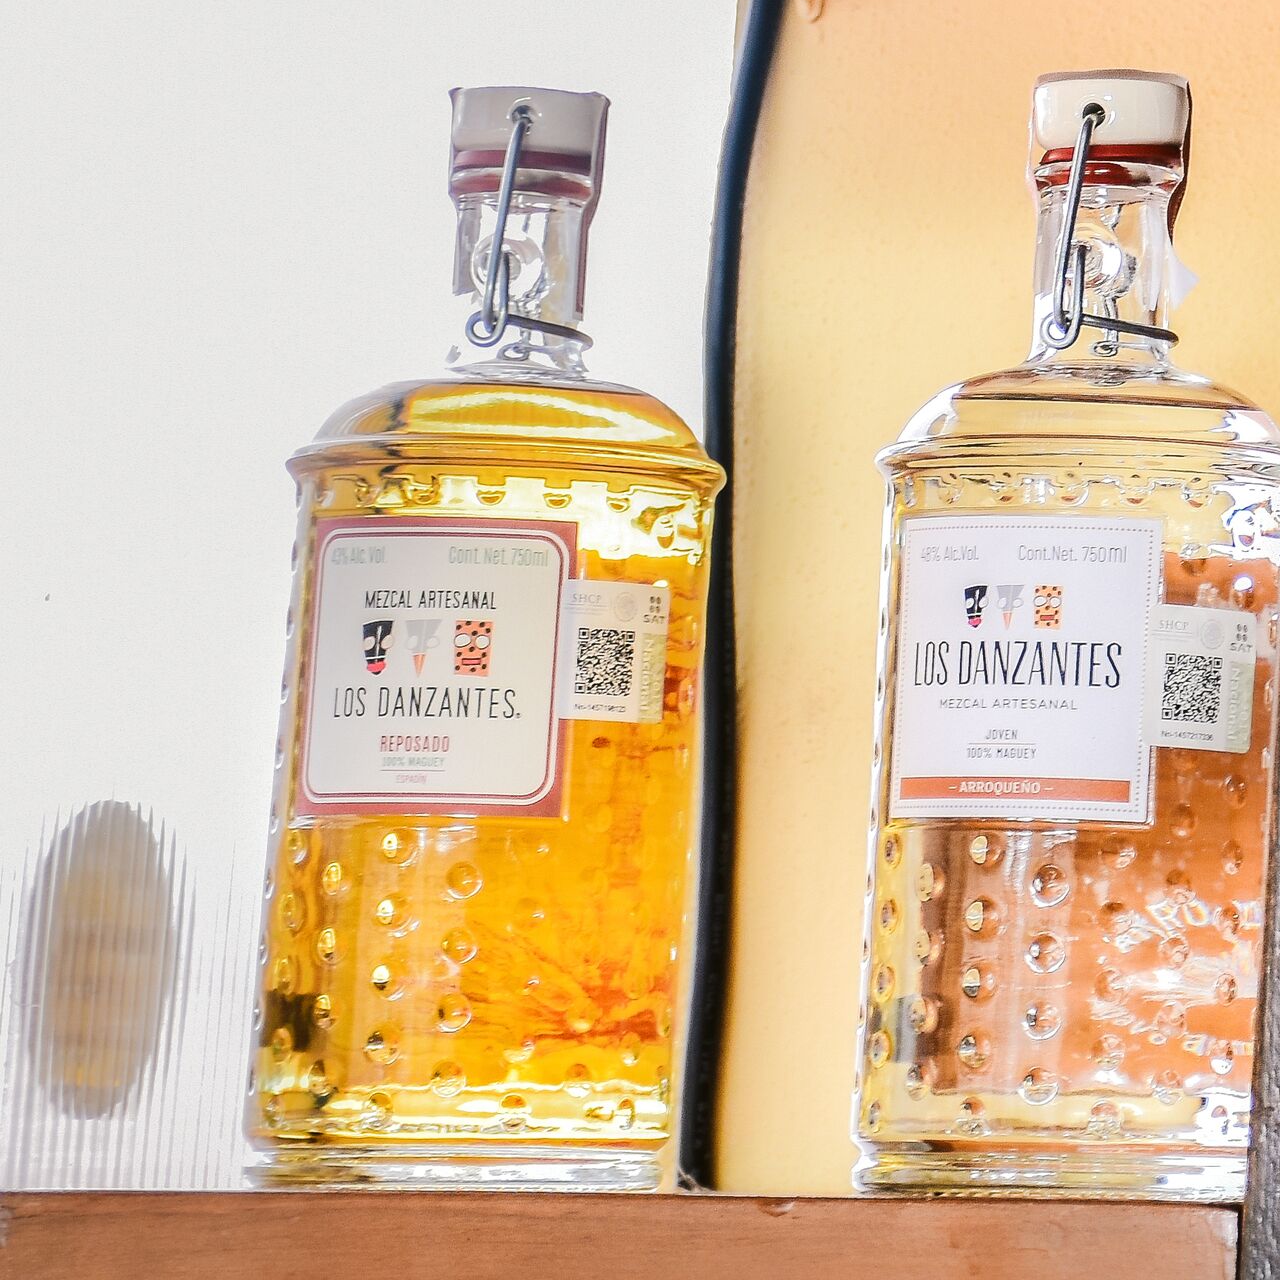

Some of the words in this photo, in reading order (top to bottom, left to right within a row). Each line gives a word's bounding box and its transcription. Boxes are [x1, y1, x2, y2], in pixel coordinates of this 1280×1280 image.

[511, 547, 549, 568] 750ml
[1082, 546, 1128, 564] 750ml
[364, 590, 412, 609] MEZCAL
[418, 590, 497, 610] ARTESANAL
[914, 640, 950, 686] LOS
[958, 640, 1122, 689] DANZANTES
[333, 687, 367, 717] LOS
[939, 698, 987, 710] MEZCAL
[992, 698, 1078, 711] ARTESANAL
[379, 735, 450, 753] REPOSADO
[985, 729, 1018, 741] JOVEN
[408, 756, 445, 768] MAGUEY
[966, 747, 993, 759] 100%
[996, 747, 1037, 759] MAGUEY
[958, 780, 1042, 796] ARROQUEÑO
